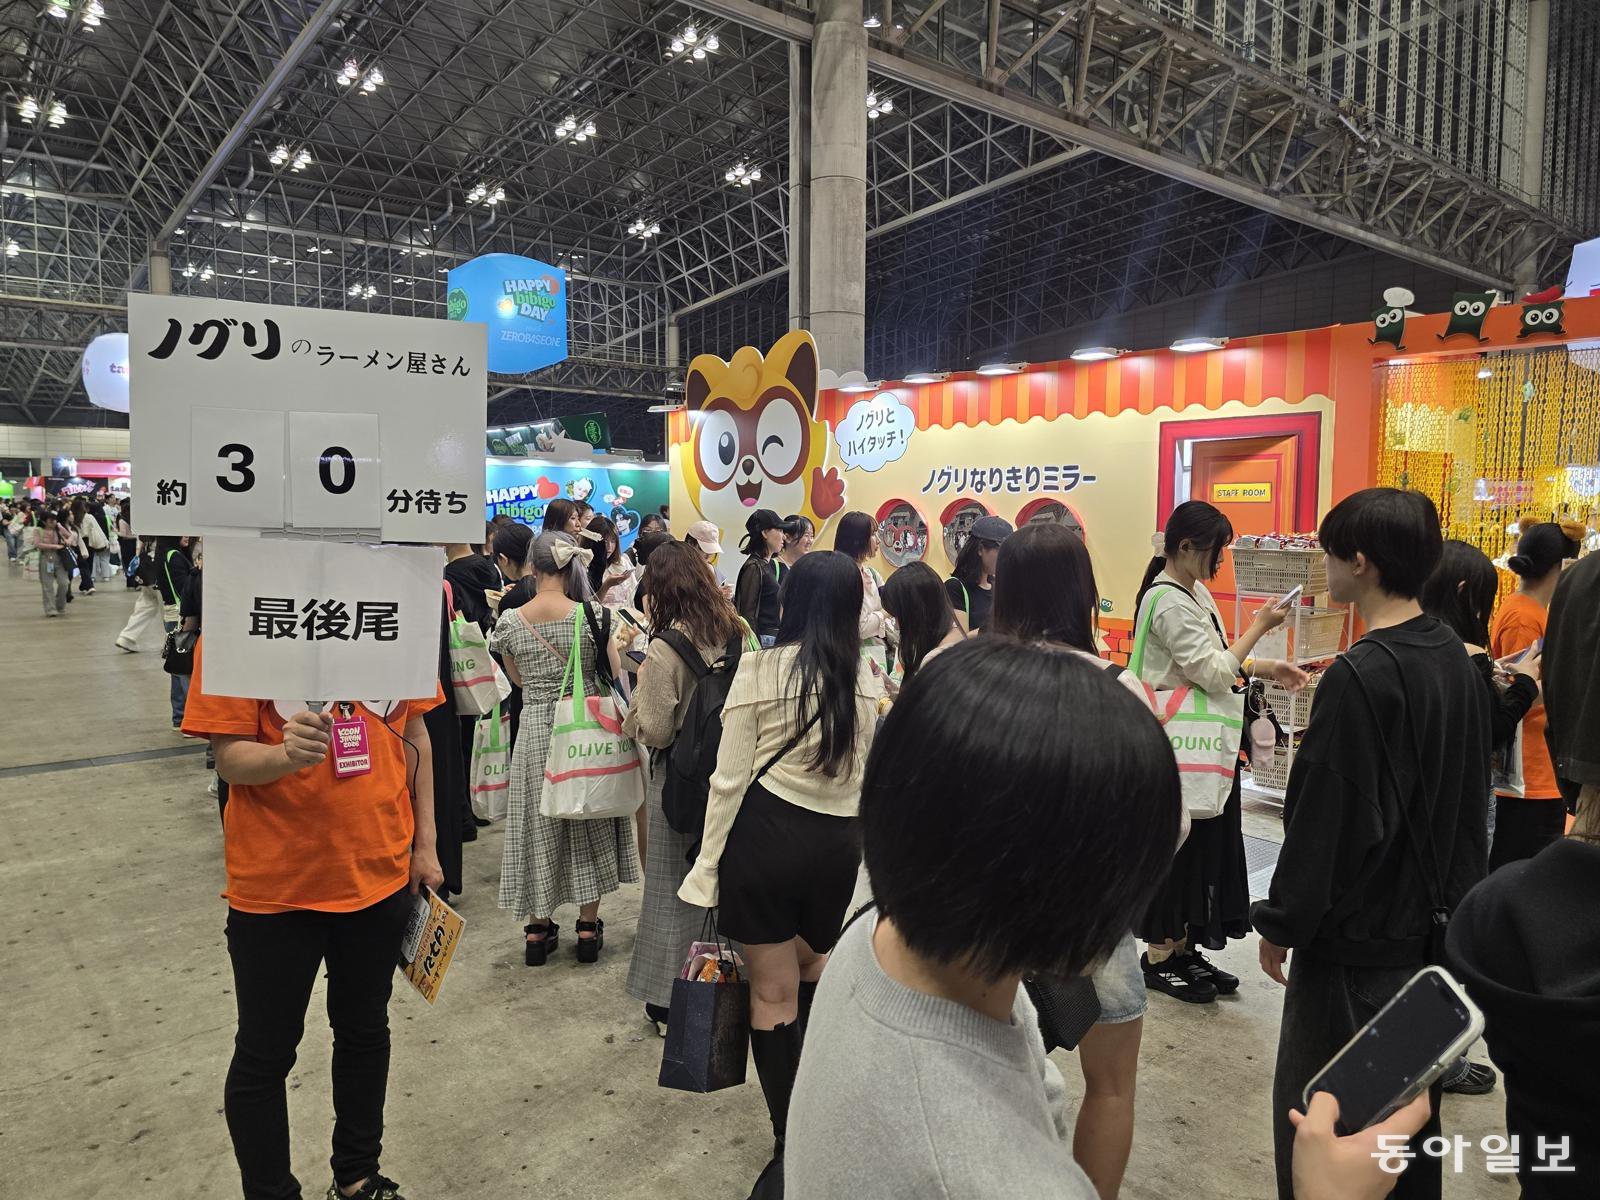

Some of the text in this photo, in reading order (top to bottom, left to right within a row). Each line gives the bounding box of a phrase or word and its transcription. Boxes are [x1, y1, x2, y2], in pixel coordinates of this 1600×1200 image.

[504, 279, 551, 293] HAPPY
[515, 291, 556, 311] bibigo
[520, 303, 549, 321] DAY
[856, 407, 896, 433] ノグリと
[921, 464, 1098, 494] ノグリなりきりミラー
[156, 478, 187, 506] 約
[386, 489, 469, 516] 分待ち
[486, 484, 539, 504] HAPPY
[1217, 488, 1266, 497] STAFF ROOM
[249, 597, 399, 641] 最後尾
[567, 742, 613, 759] OLIVE
[339, 759, 368, 769] EXHIBITOR
